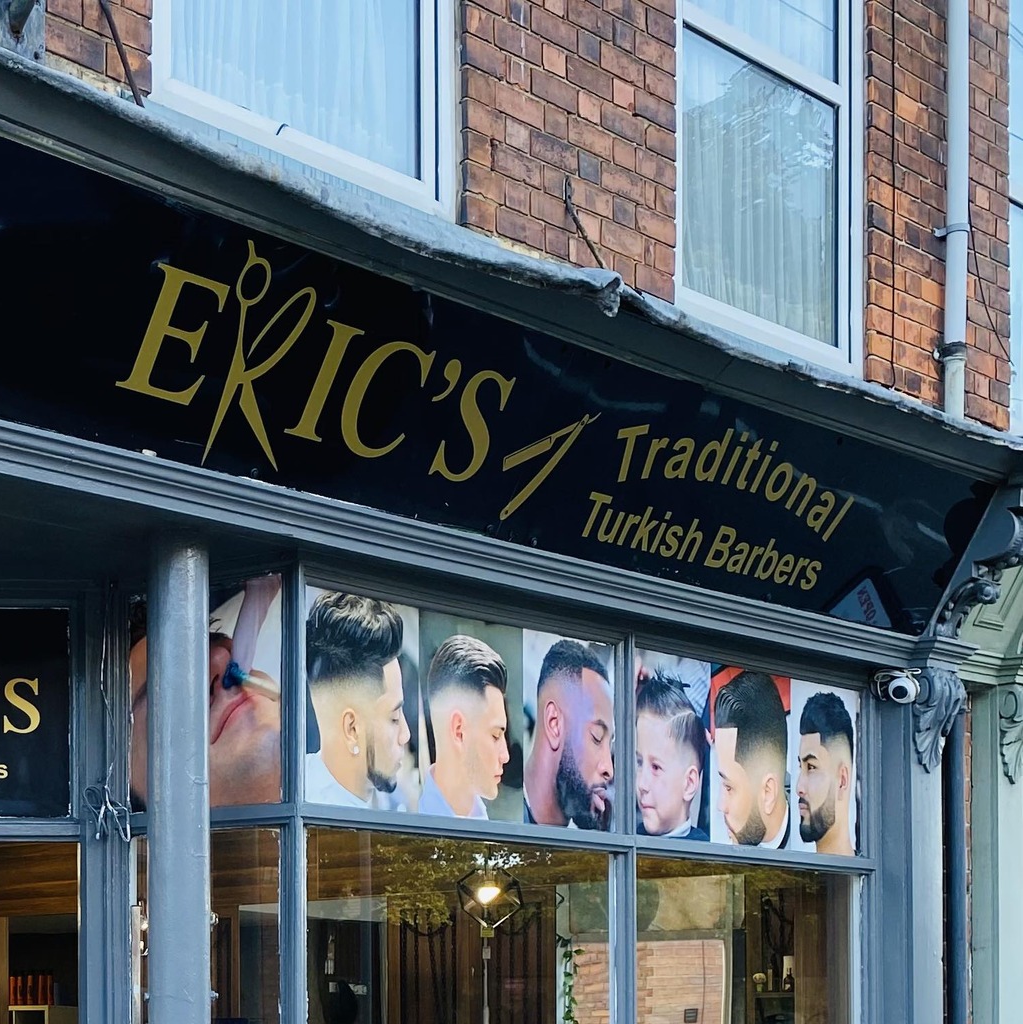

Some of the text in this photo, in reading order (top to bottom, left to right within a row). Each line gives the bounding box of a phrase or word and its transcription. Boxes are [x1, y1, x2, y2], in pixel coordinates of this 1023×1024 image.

[115, 240, 516, 482] ERIC'S
[581, 491, 823, 591] Turkish Barbers
[616, 424, 855, 542] Traditional
